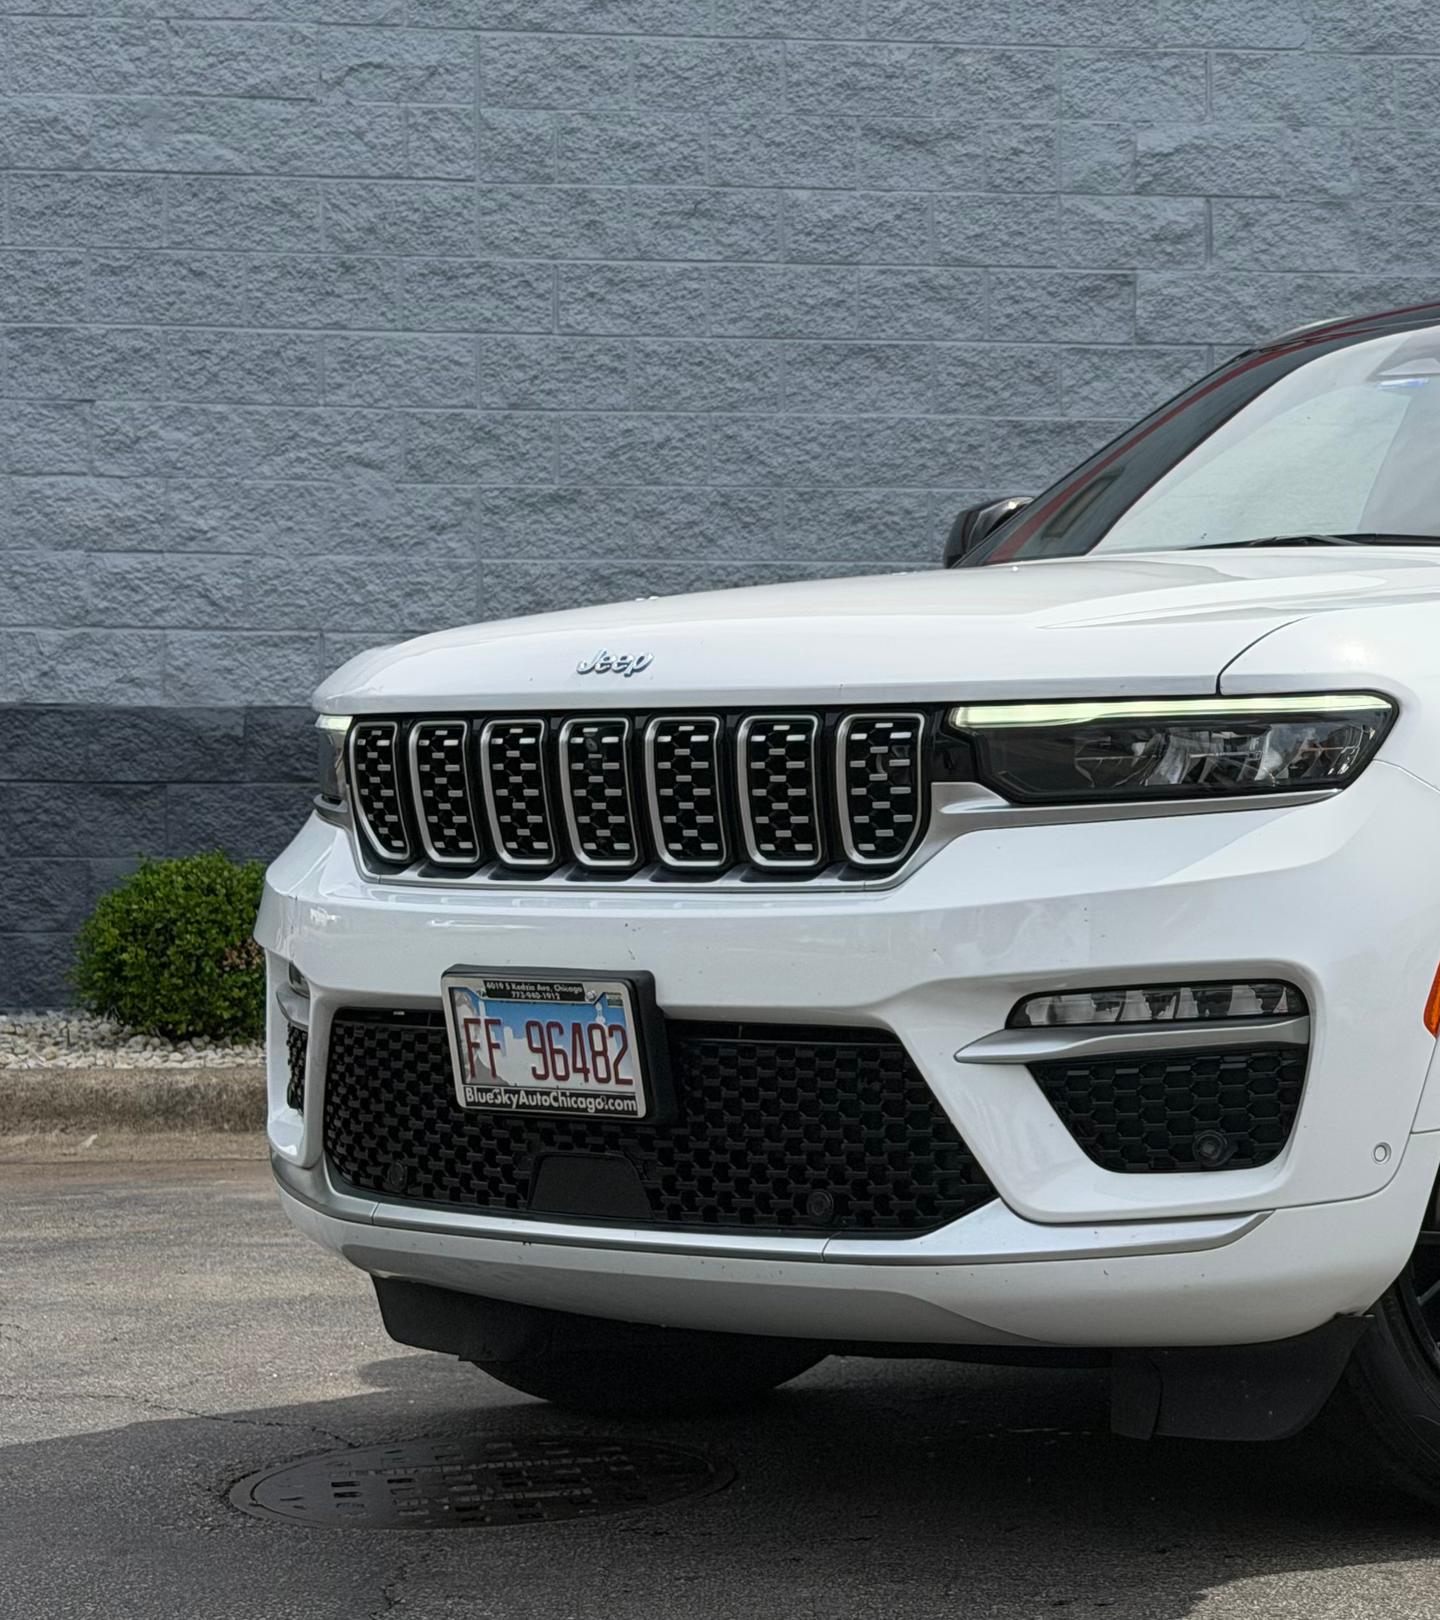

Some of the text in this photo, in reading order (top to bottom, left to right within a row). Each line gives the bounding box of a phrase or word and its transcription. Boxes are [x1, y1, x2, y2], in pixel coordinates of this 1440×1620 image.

[576, 648, 654, 678] Jeep
[553, 983, 582, 995] Chicago
[463, 1018, 633, 1086] FF 96482
[465, 1087, 637, 1113] BlueSkyAutoChicago.com
